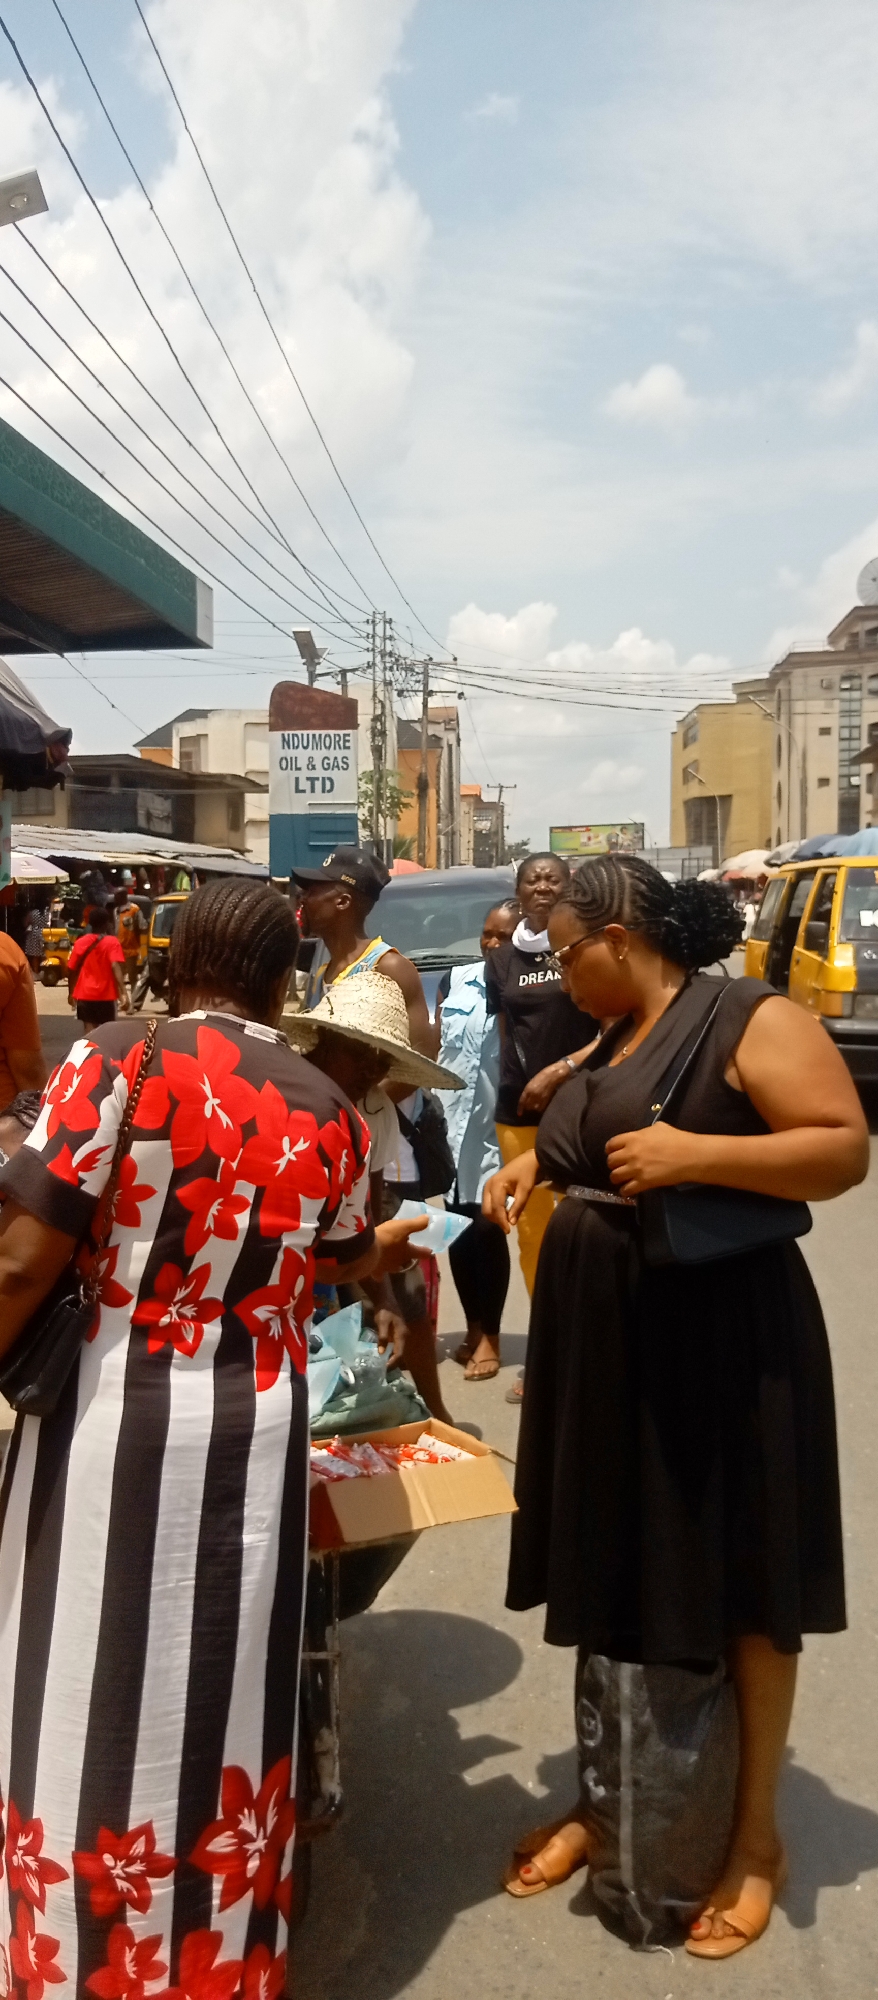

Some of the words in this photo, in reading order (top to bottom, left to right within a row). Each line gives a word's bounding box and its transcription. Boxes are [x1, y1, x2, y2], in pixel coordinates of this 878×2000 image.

[281, 733, 351, 750] NDUMORE
[279, 756, 302, 771] OIL
[306, 756, 316, 771] &
[321, 756, 350, 771] GAS
[294, 776, 335, 794] LTD
